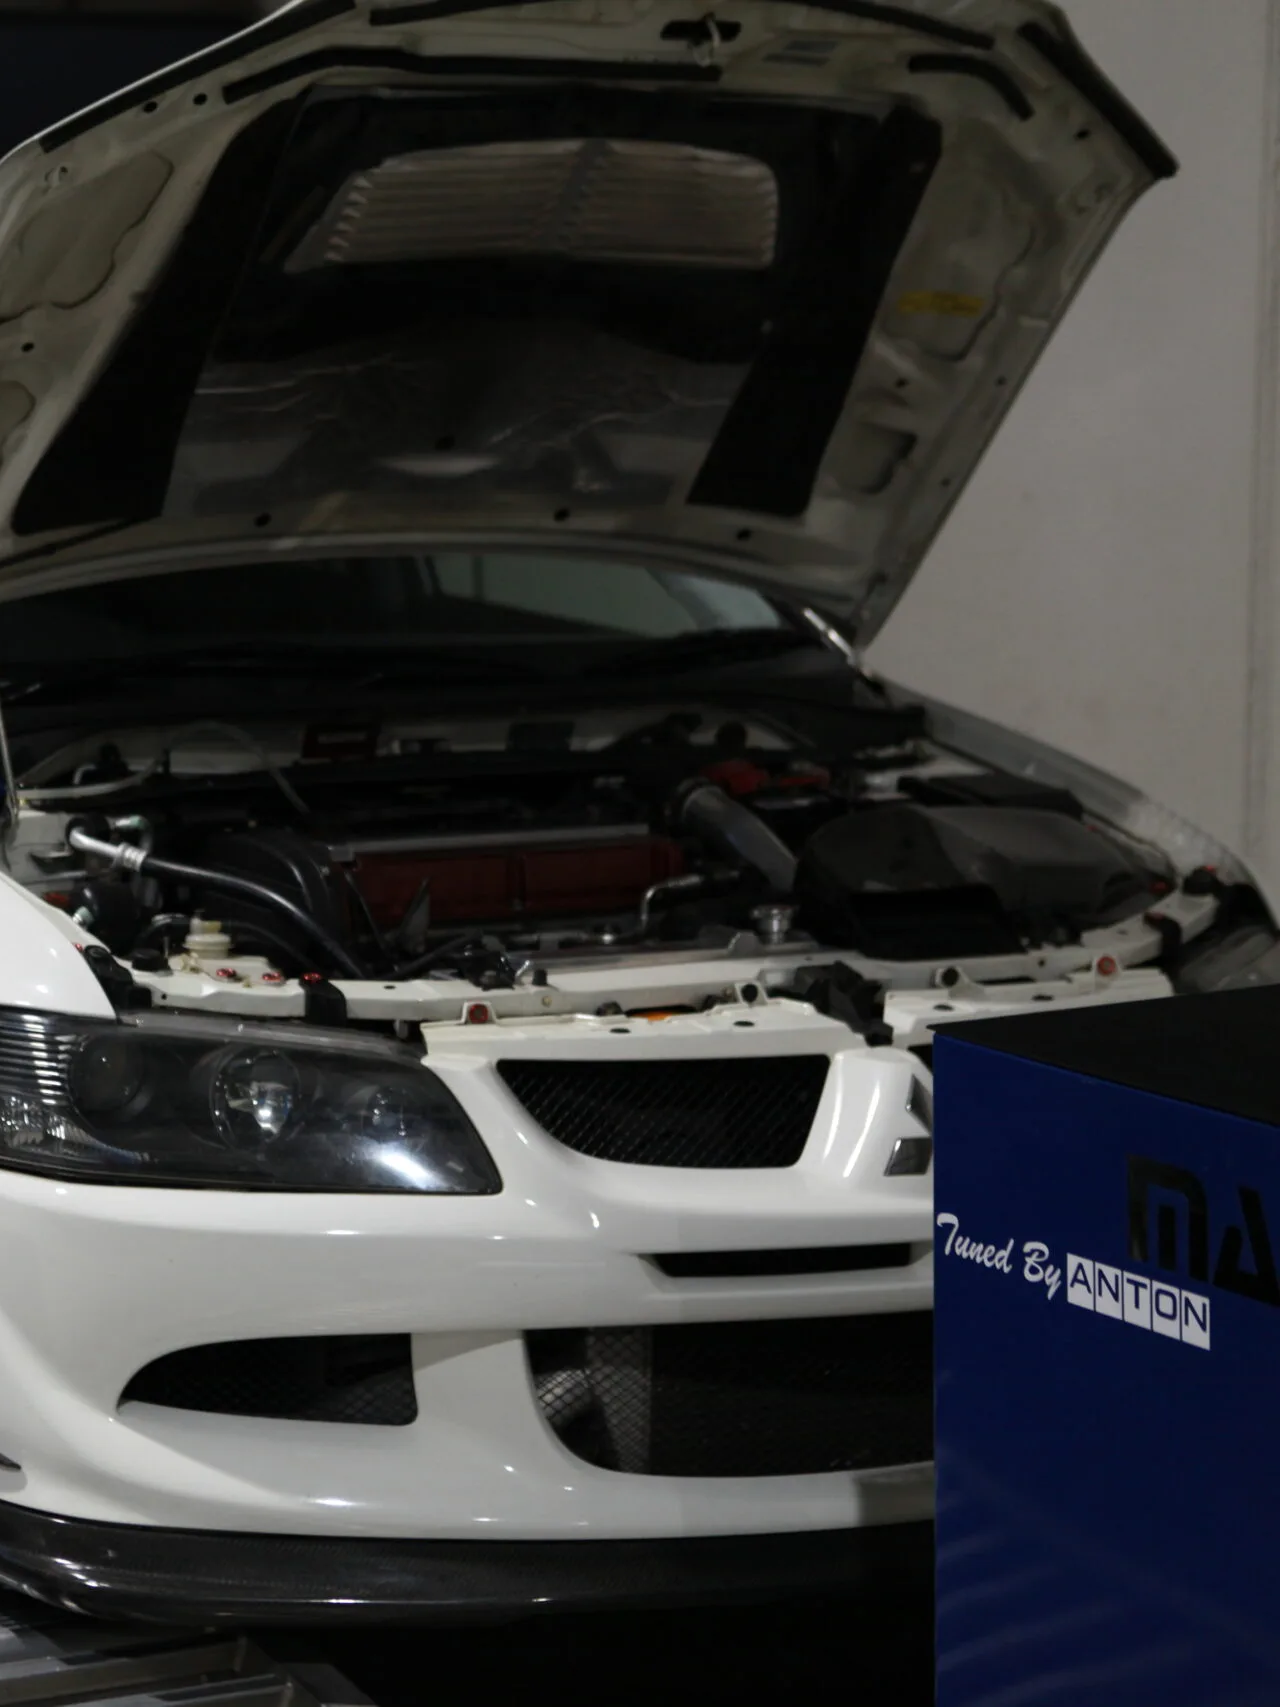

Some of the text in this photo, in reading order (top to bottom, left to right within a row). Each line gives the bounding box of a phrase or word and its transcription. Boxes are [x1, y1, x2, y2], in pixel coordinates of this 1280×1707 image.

[936, 1212, 1209, 1340] Tuned By ANTON
